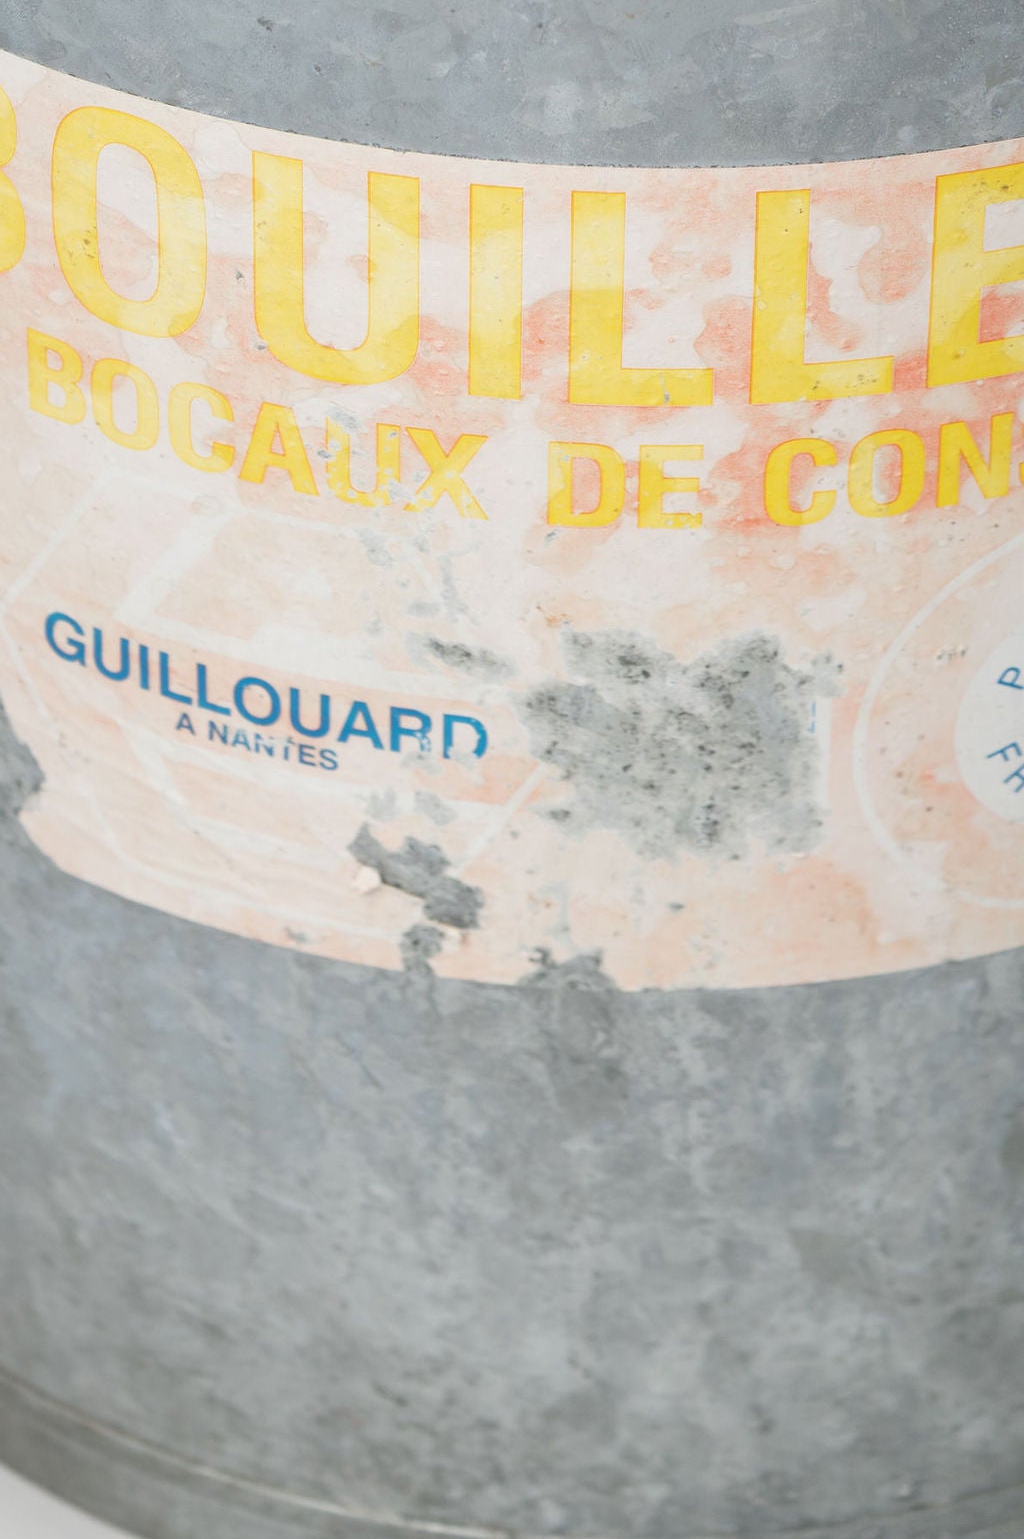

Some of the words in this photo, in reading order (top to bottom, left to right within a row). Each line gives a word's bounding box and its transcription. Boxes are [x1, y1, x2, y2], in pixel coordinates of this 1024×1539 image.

[27, 327, 488, 520] BOCAUX
[547, 440, 704, 529] DE
[764, 411, 1024, 527] CON
[44, 611, 488, 760] GUILLOUARD
[176, 712, 196, 736] A
[208, 719, 339, 771] NANTES
